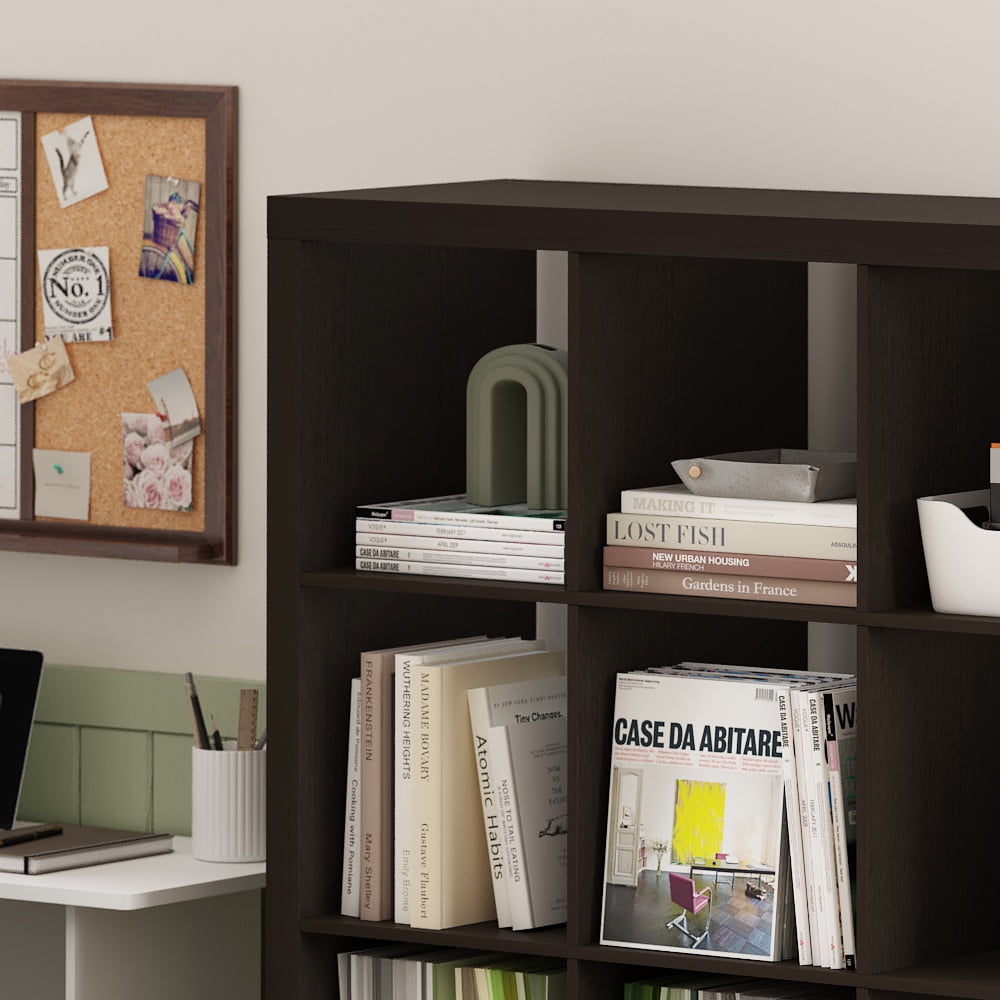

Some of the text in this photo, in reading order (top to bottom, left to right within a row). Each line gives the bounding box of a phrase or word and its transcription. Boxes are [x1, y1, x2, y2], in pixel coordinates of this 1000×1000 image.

[50, 275, 104, 298] No. 1
[632, 497, 695, 513] MAKING
[698, 502, 716, 514] IT
[614, 520, 725, 546] LOST FISH
[360, 548, 400, 558] CASE DA ABITARE
[360, 561, 400, 571] CASE DA ABITARE
[652, 552, 750, 567] NEW URBAN HOUSING
[677, 563, 704, 571] FRENCH
[682, 577, 796, 596] Gardens in France
[402, 660, 411, 780] WUTHERING HEIGHTS
[421, 672, 430, 781] MADAME BOVARY
[780, 712, 787, 720] DA
[811, 716, 818, 724] DA
[615, 718, 664, 748] CASE
[669, 722, 695, 750] DA
[699, 725, 782, 758] ABITARE
[781, 722, 789, 748] ABITARE
[812, 726, 820, 752] ABITARE
[349, 779, 358, 822] Cooking
[502, 780, 510, 806] NOSE
[476, 736, 504, 880] Atomic Habits
[505, 809, 512, 823] TO
[346, 850, 354, 895] Pomiane
[364, 833, 372, 909] Mary Shelley
[400, 850, 410, 876] Emily
[420, 823, 429, 919] Gustave Flaubert
[511, 847, 520, 883] EATING
